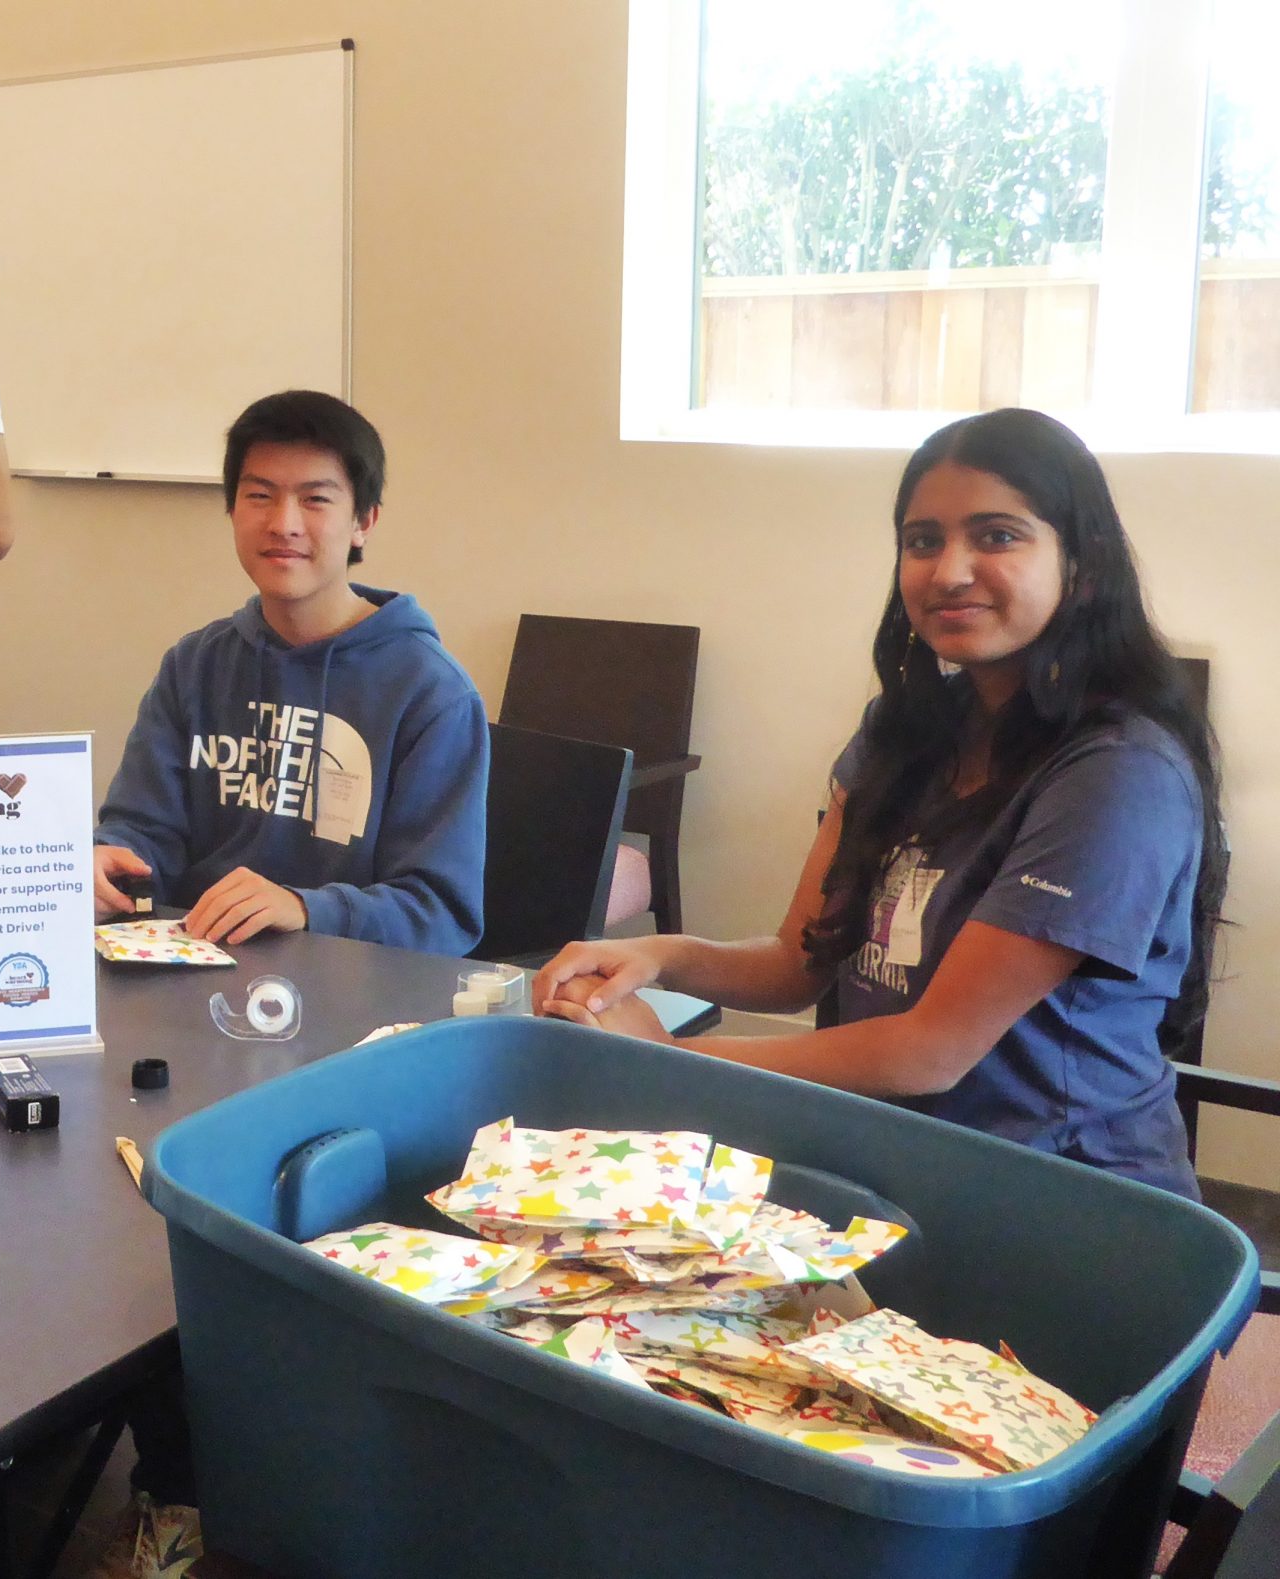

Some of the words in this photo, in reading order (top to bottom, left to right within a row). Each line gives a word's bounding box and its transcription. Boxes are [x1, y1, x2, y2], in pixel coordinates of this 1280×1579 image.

[248, 701, 319, 746] THE
[189, 735, 312, 782] NORTH
[220, 771, 305, 817] FACE
[20, 843, 33, 855] to
[35, 841, 75, 854] thank
[24, 862, 51, 874] and
[53, 860, 75, 873] the
[11, 880, 84, 897] supporting
[1029, 876, 1073, 899] Columbia
[6, 920, 45, 934] Drive!
